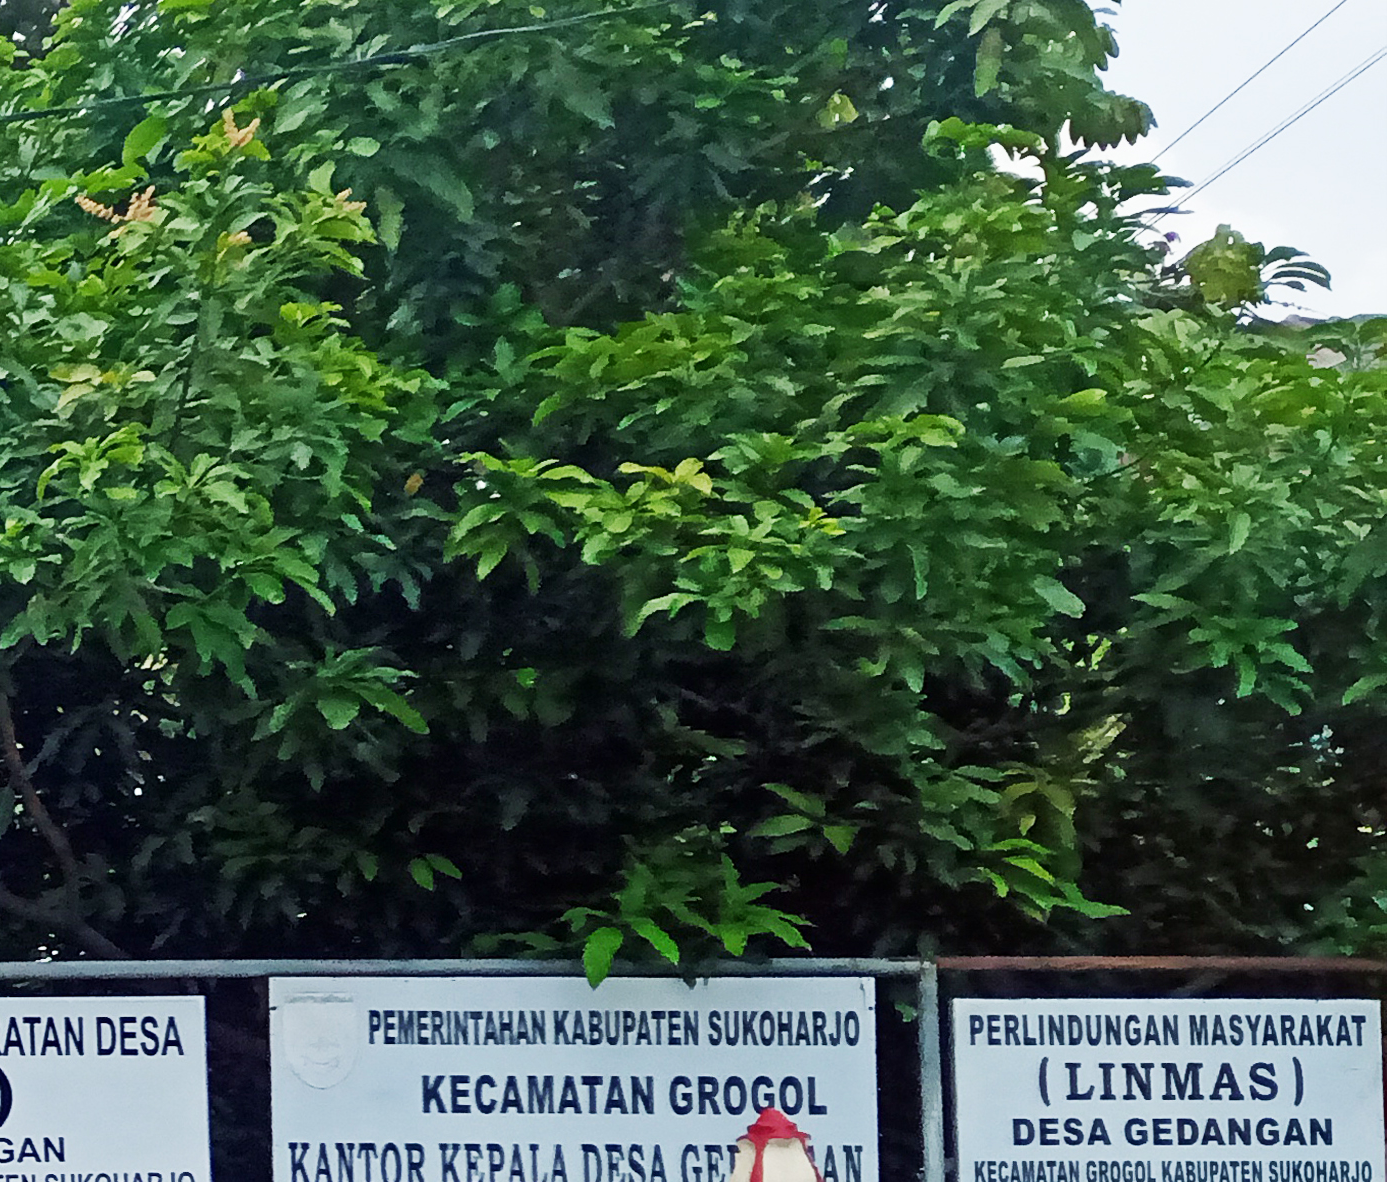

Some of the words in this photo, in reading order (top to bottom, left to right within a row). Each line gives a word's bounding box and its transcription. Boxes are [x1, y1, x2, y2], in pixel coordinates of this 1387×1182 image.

[95, 1015, 185, 1057] DESA
[368, 1009, 547, 1046] PEMERINTAHAN
[553, 1010, 699, 1046] KABUPATEN
[707, 1009, 860, 1047] SUKOHARJO
[969, 1014, 1180, 1047] PERLINDUNGAN
[1188, 1014, 1367, 1047] MASYARAKAT
[421, 1074, 655, 1115] KECAMATAN
[668, 1075, 829, 1116] GROGOL
[1012, 1117, 1112, 1146] DESA
[1124, 1117, 1333, 1146] GEDANGAN
